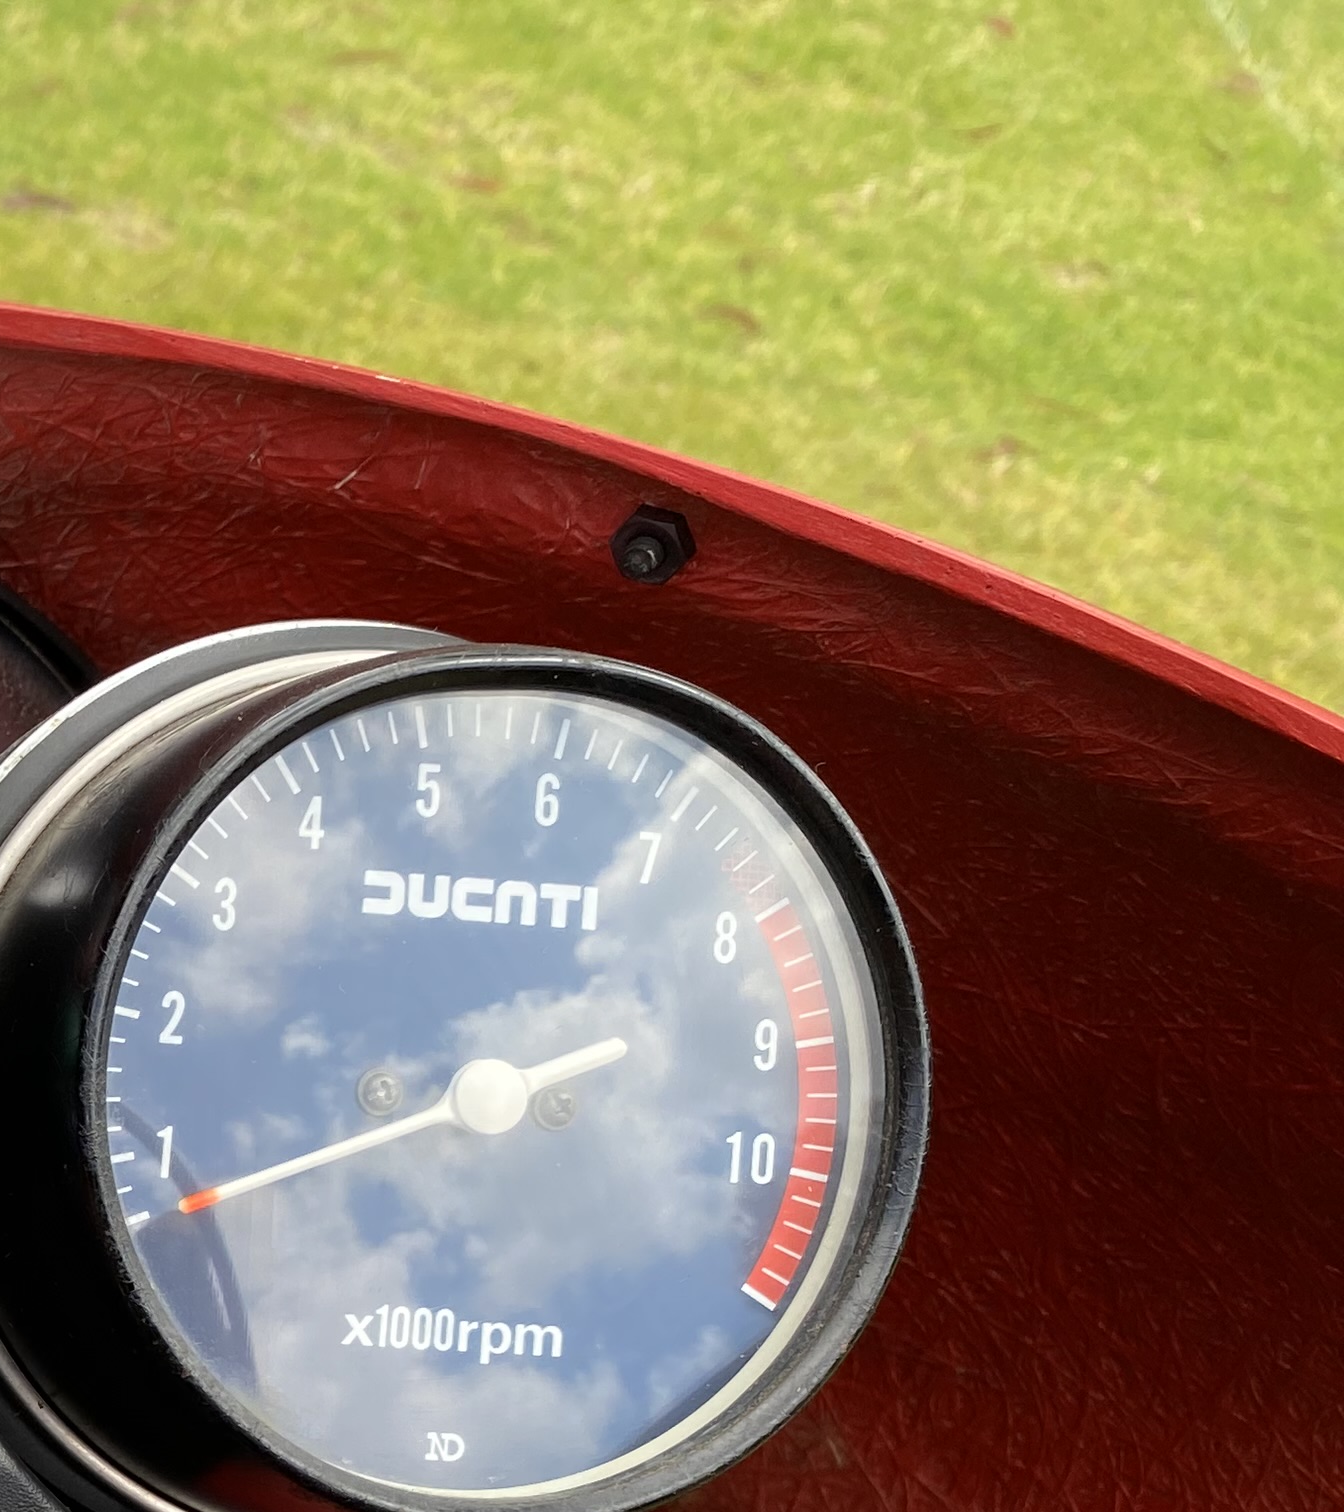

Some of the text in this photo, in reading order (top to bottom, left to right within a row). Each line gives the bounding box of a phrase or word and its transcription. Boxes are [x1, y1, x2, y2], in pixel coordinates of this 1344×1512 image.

[415, 763, 442, 818] 5
[534, 772, 561, 827] 6
[298, 795, 325, 850] 4
[639, 831, 663, 884] 7
[212, 876, 238, 931] 3
[361, 869, 599, 931] DUCATI
[713, 910, 738, 964] 8
[158, 990, 186, 1045] 2
[753, 1018, 779, 1071] 9
[156, 1125, 174, 1179] 1
[725, 1131, 776, 1185] 10
[340, 1303, 563, 1365] x1000rpm
